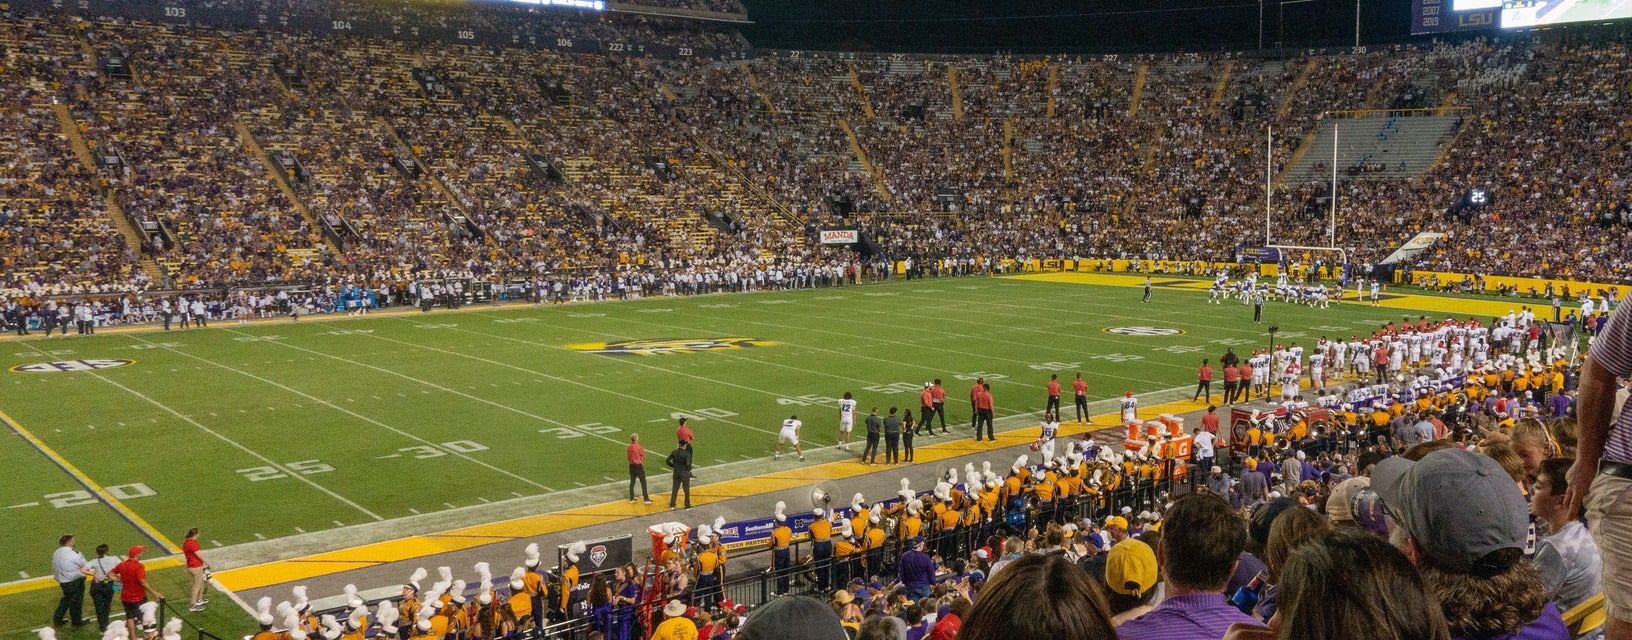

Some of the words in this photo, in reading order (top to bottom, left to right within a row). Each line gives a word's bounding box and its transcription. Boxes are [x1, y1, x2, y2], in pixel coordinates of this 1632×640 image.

[164, 7, 186, 17] 103
[1423, 6, 1440, 15] 2007
[332, 20, 352, 30] 104
[1459, 13, 1493, 27] LSU
[458, 31, 475, 40] 105
[557, 38, 573, 47] 106
[608, 43, 624, 51] 222
[679, 48, 693, 56] 223
[1471, 191, 1485, 202] 25
[823, 231, 854, 240] MANDA
[776, 394, 839, 406] 45
[1124, 401, 1135, 409] 84
[841, 404, 851, 412] 12
[539, 422, 623, 439] 35
[398, 440, 490, 459] 30
[1178, 441, 1188, 456] G
[236, 459, 336, 481] 25
[44, 482, 159, 508] 20
